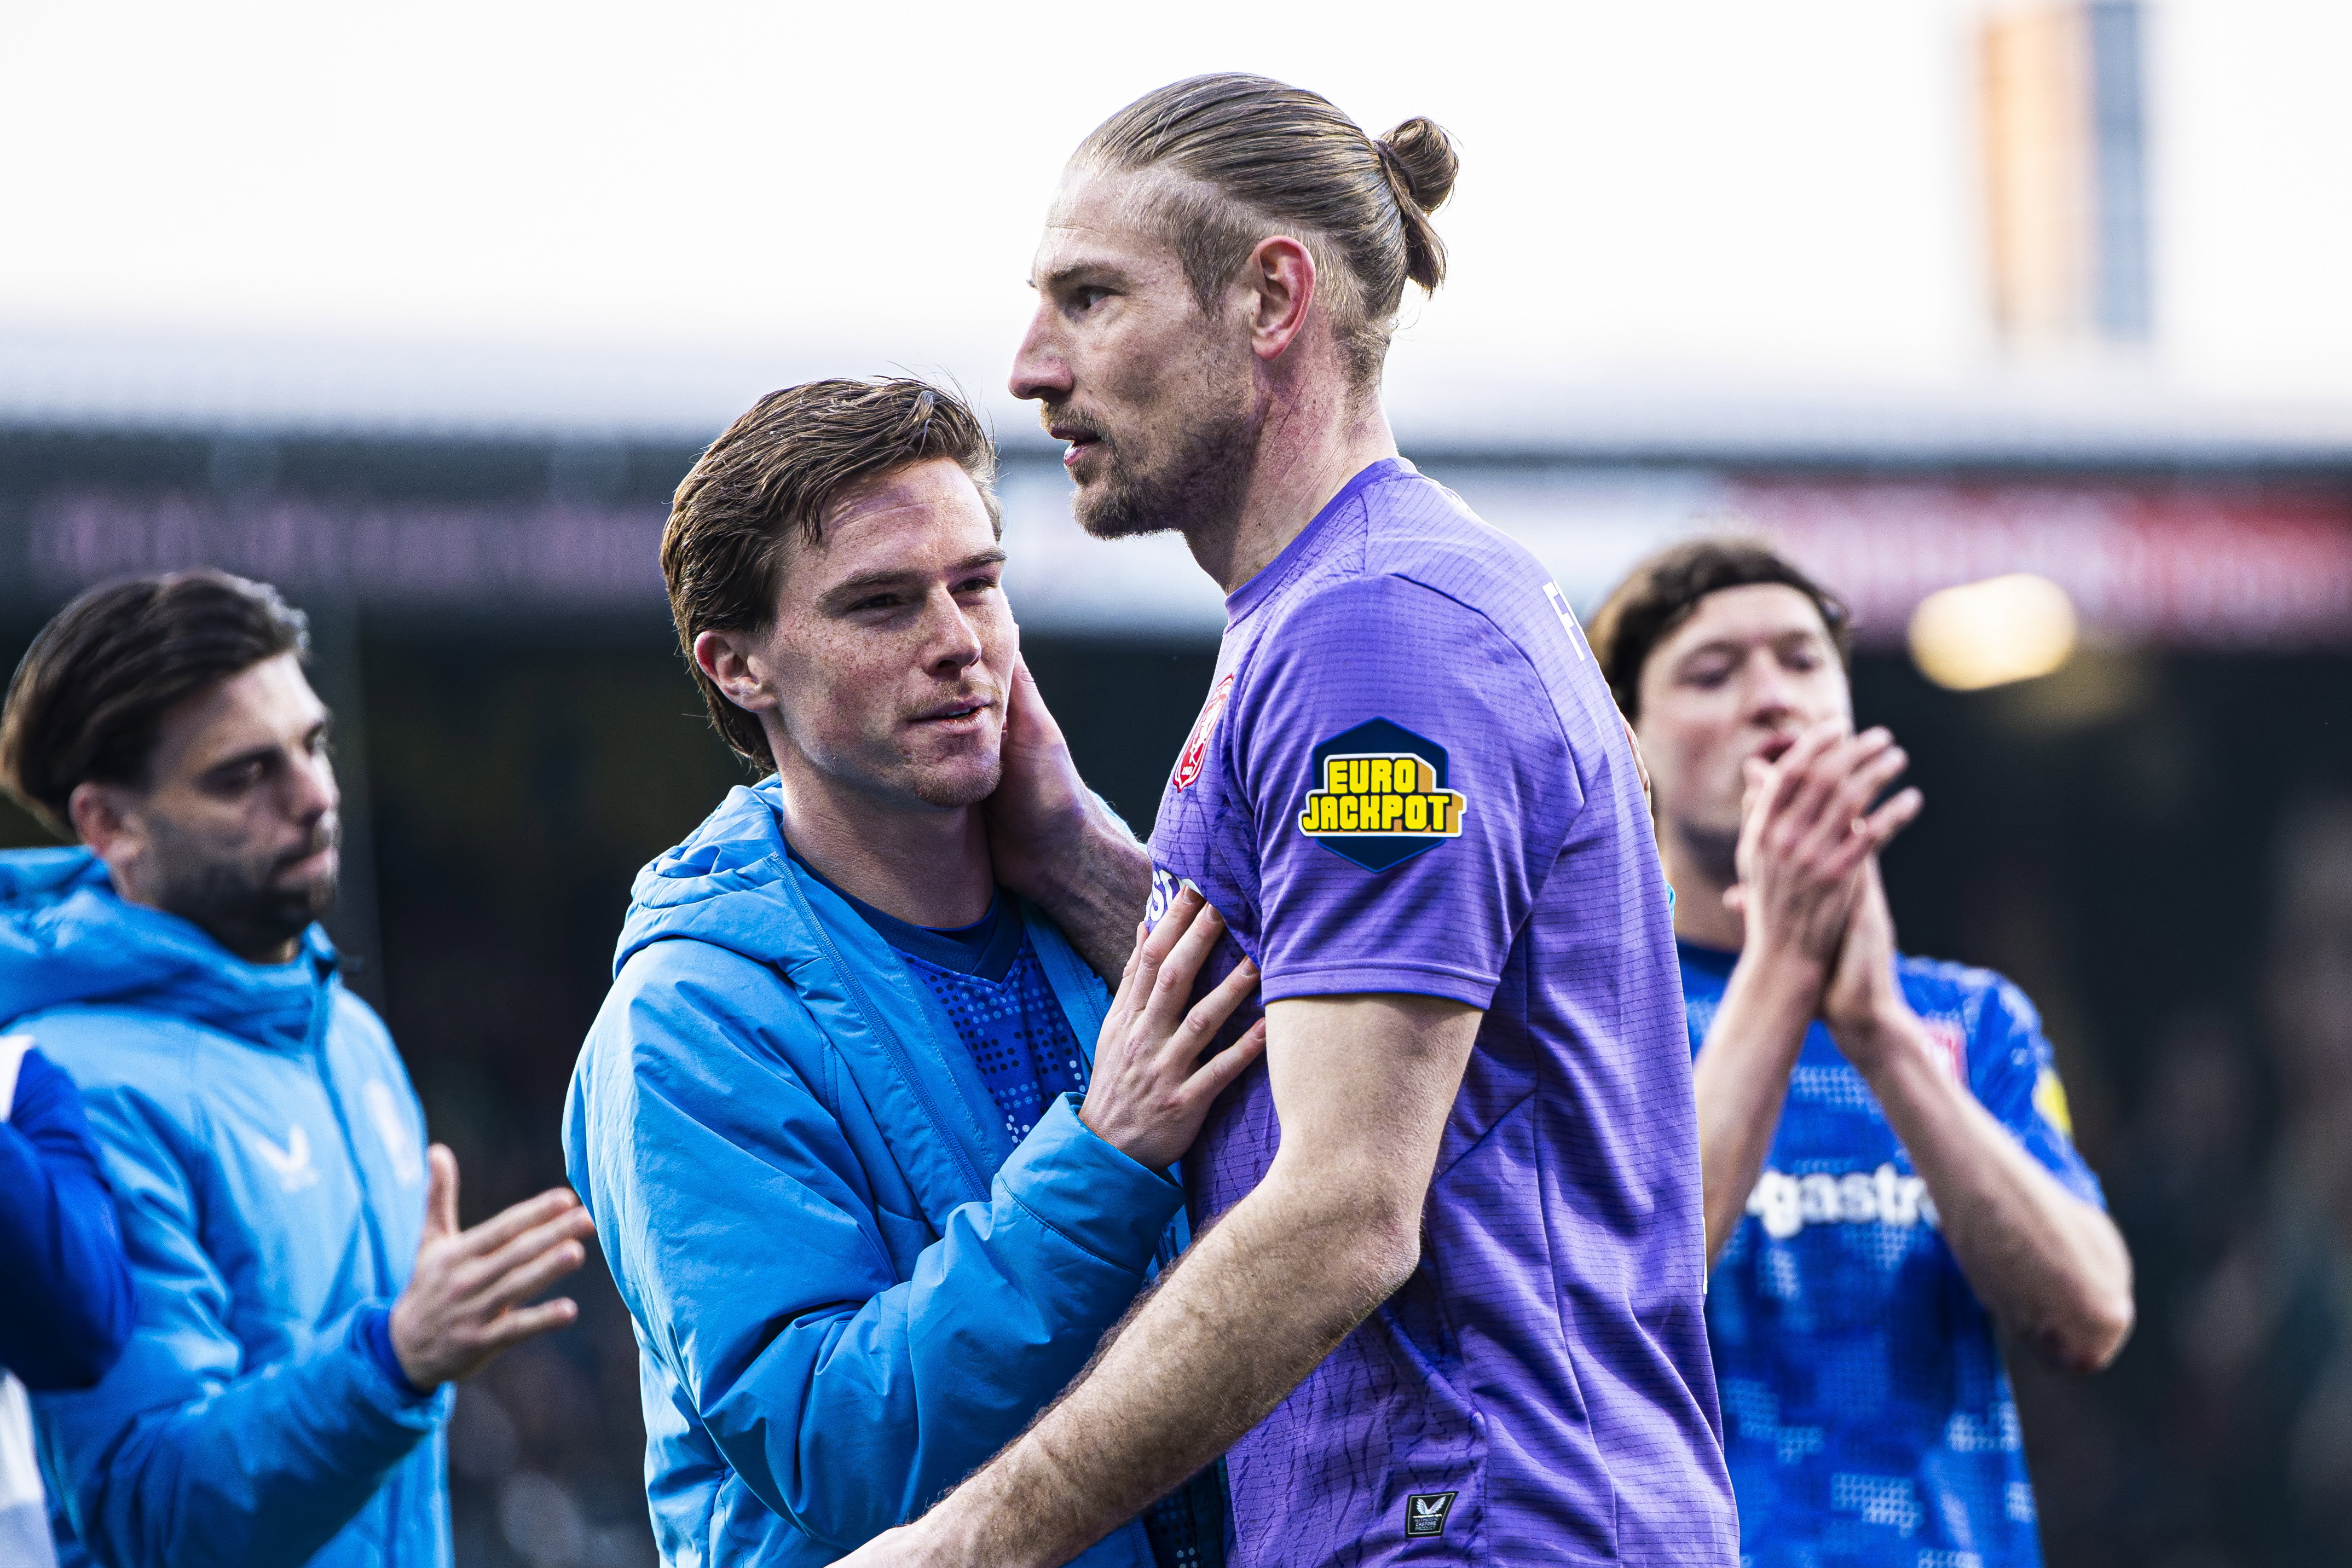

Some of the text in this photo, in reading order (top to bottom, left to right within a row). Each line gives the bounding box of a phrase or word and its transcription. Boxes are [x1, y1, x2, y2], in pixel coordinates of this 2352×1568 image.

[1542, 580, 1592, 661] F
[1328, 759, 1416, 794] EURO
[1302, 794, 1450, 830] JACKPOT
